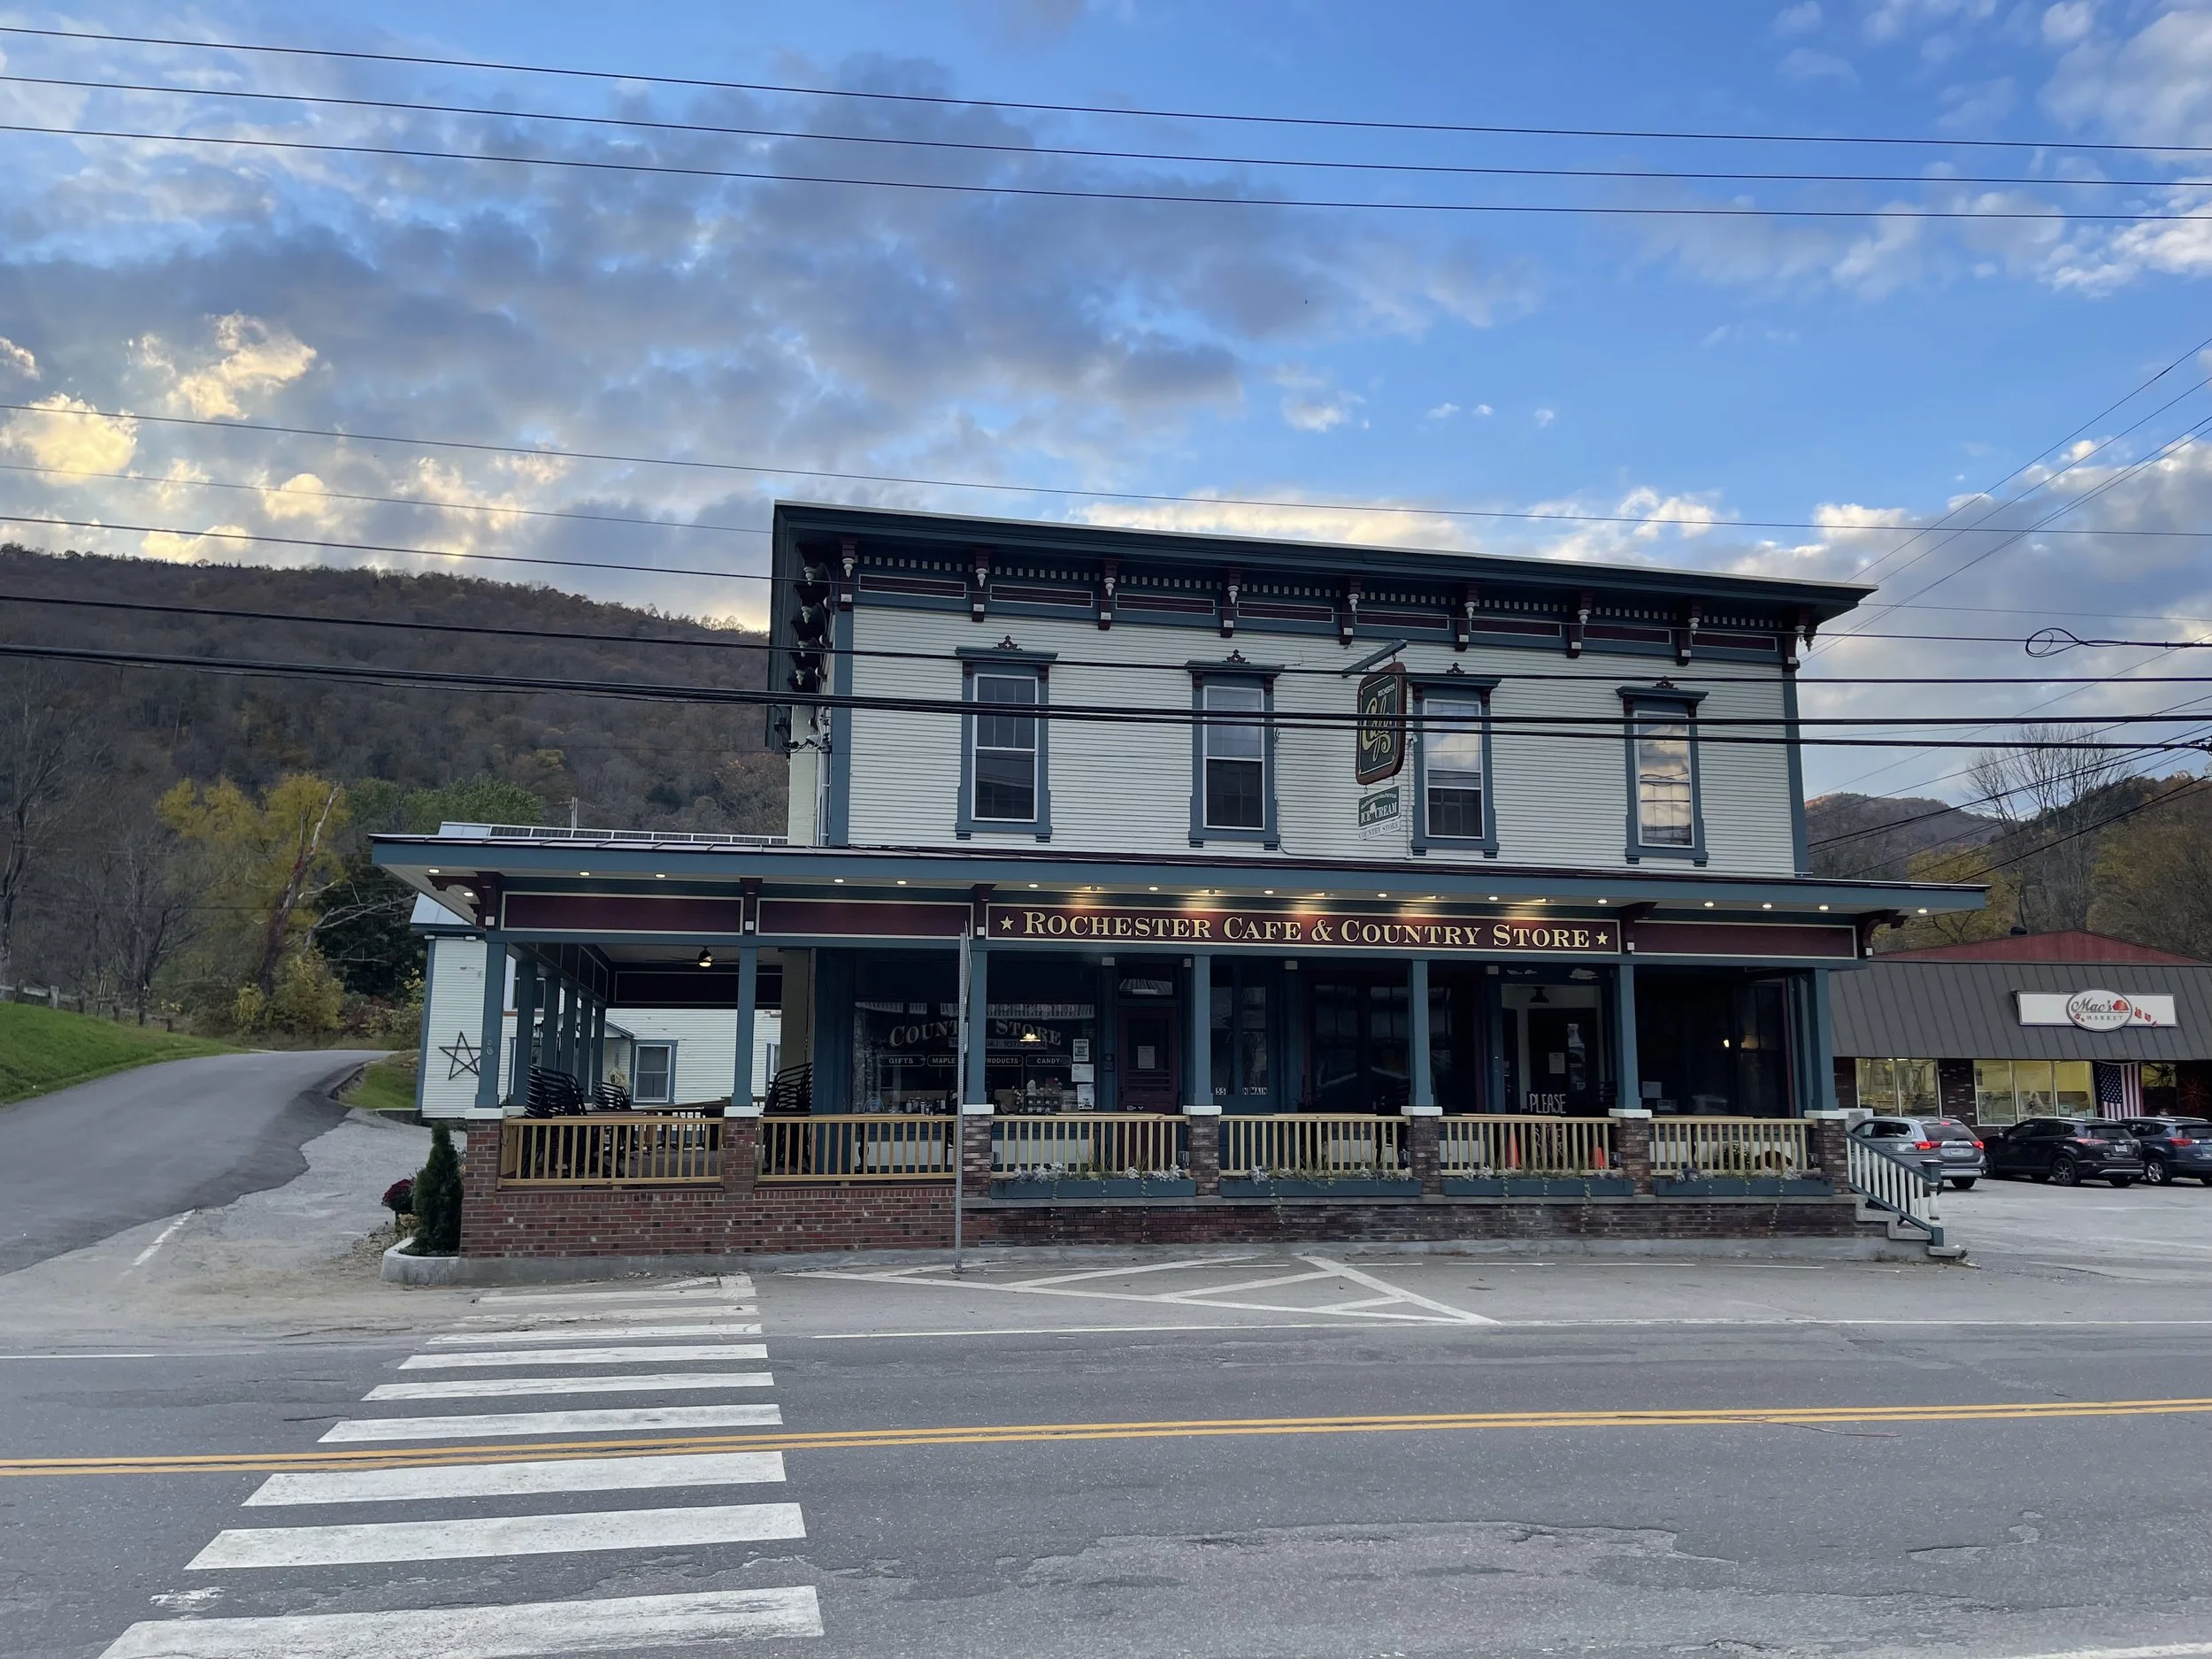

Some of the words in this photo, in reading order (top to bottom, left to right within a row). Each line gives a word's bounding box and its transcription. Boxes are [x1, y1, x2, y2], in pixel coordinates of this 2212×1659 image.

[1361, 810, 1371, 824] ICE
[1375, 802, 1398, 818] CREAM
[1023, 910, 1212, 939] ROCHESTER
[1223, 917, 1302, 941] CAFE
[1311, 919, 1333, 941] &
[1339, 919, 1481, 946] COUNTRY
[1492, 924, 1590, 949] STORE
[2071, 998, 2112, 1012] Mac's
[888, 1019, 958, 1048] COUNT
[995, 1018, 1062, 1048] STORE
[1529, 1093, 1567, 1114] PLEASE
